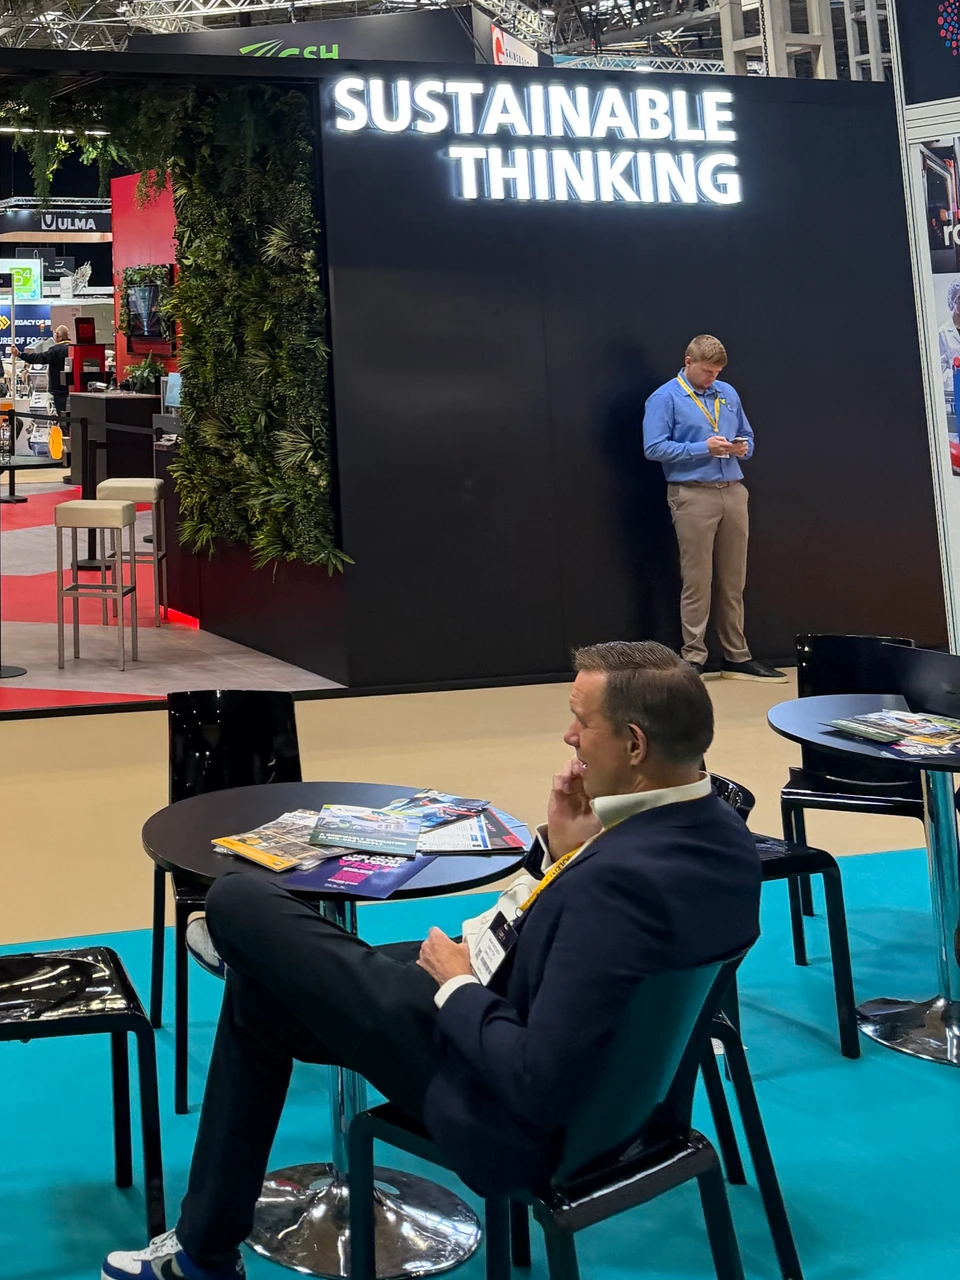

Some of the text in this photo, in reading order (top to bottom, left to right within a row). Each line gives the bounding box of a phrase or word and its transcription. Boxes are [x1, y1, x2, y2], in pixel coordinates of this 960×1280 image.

[332, 77, 738, 142] SUSTAINABLE
[448, 145, 743, 205] THINKING
[57, 218, 97, 230] ULMA
[14, 336, 25, 345] OF
